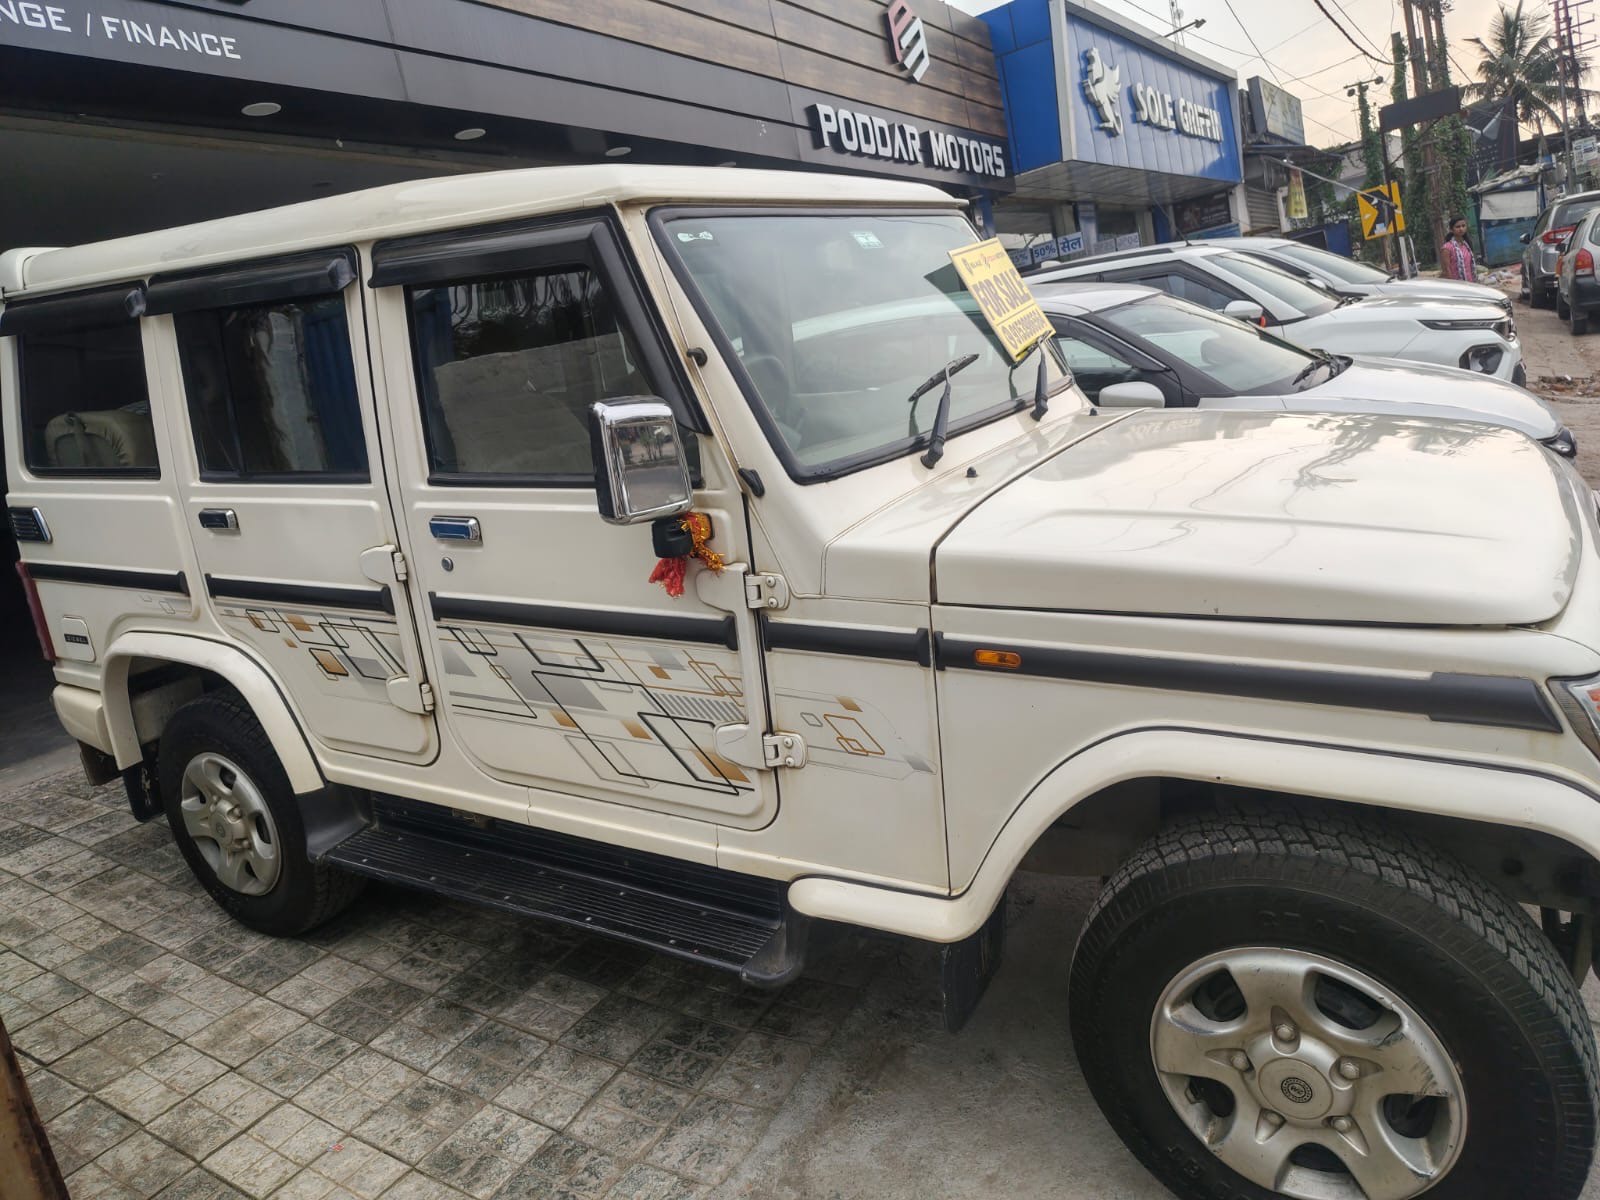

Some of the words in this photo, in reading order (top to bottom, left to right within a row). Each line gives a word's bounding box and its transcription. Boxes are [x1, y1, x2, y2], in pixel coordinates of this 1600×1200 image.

[101, 16, 242, 60] FINANCE
[1136, 82, 1176, 130] SOLE
[815, 103, 923, 164] PODDAR
[929, 130, 1006, 178] MOTORS
[1033, 244, 1057, 258] 50%
[1060, 237, 1082, 252] सेल
[972, 278, 1010, 321] FOR
[993, 268, 1032, 310] SALE
